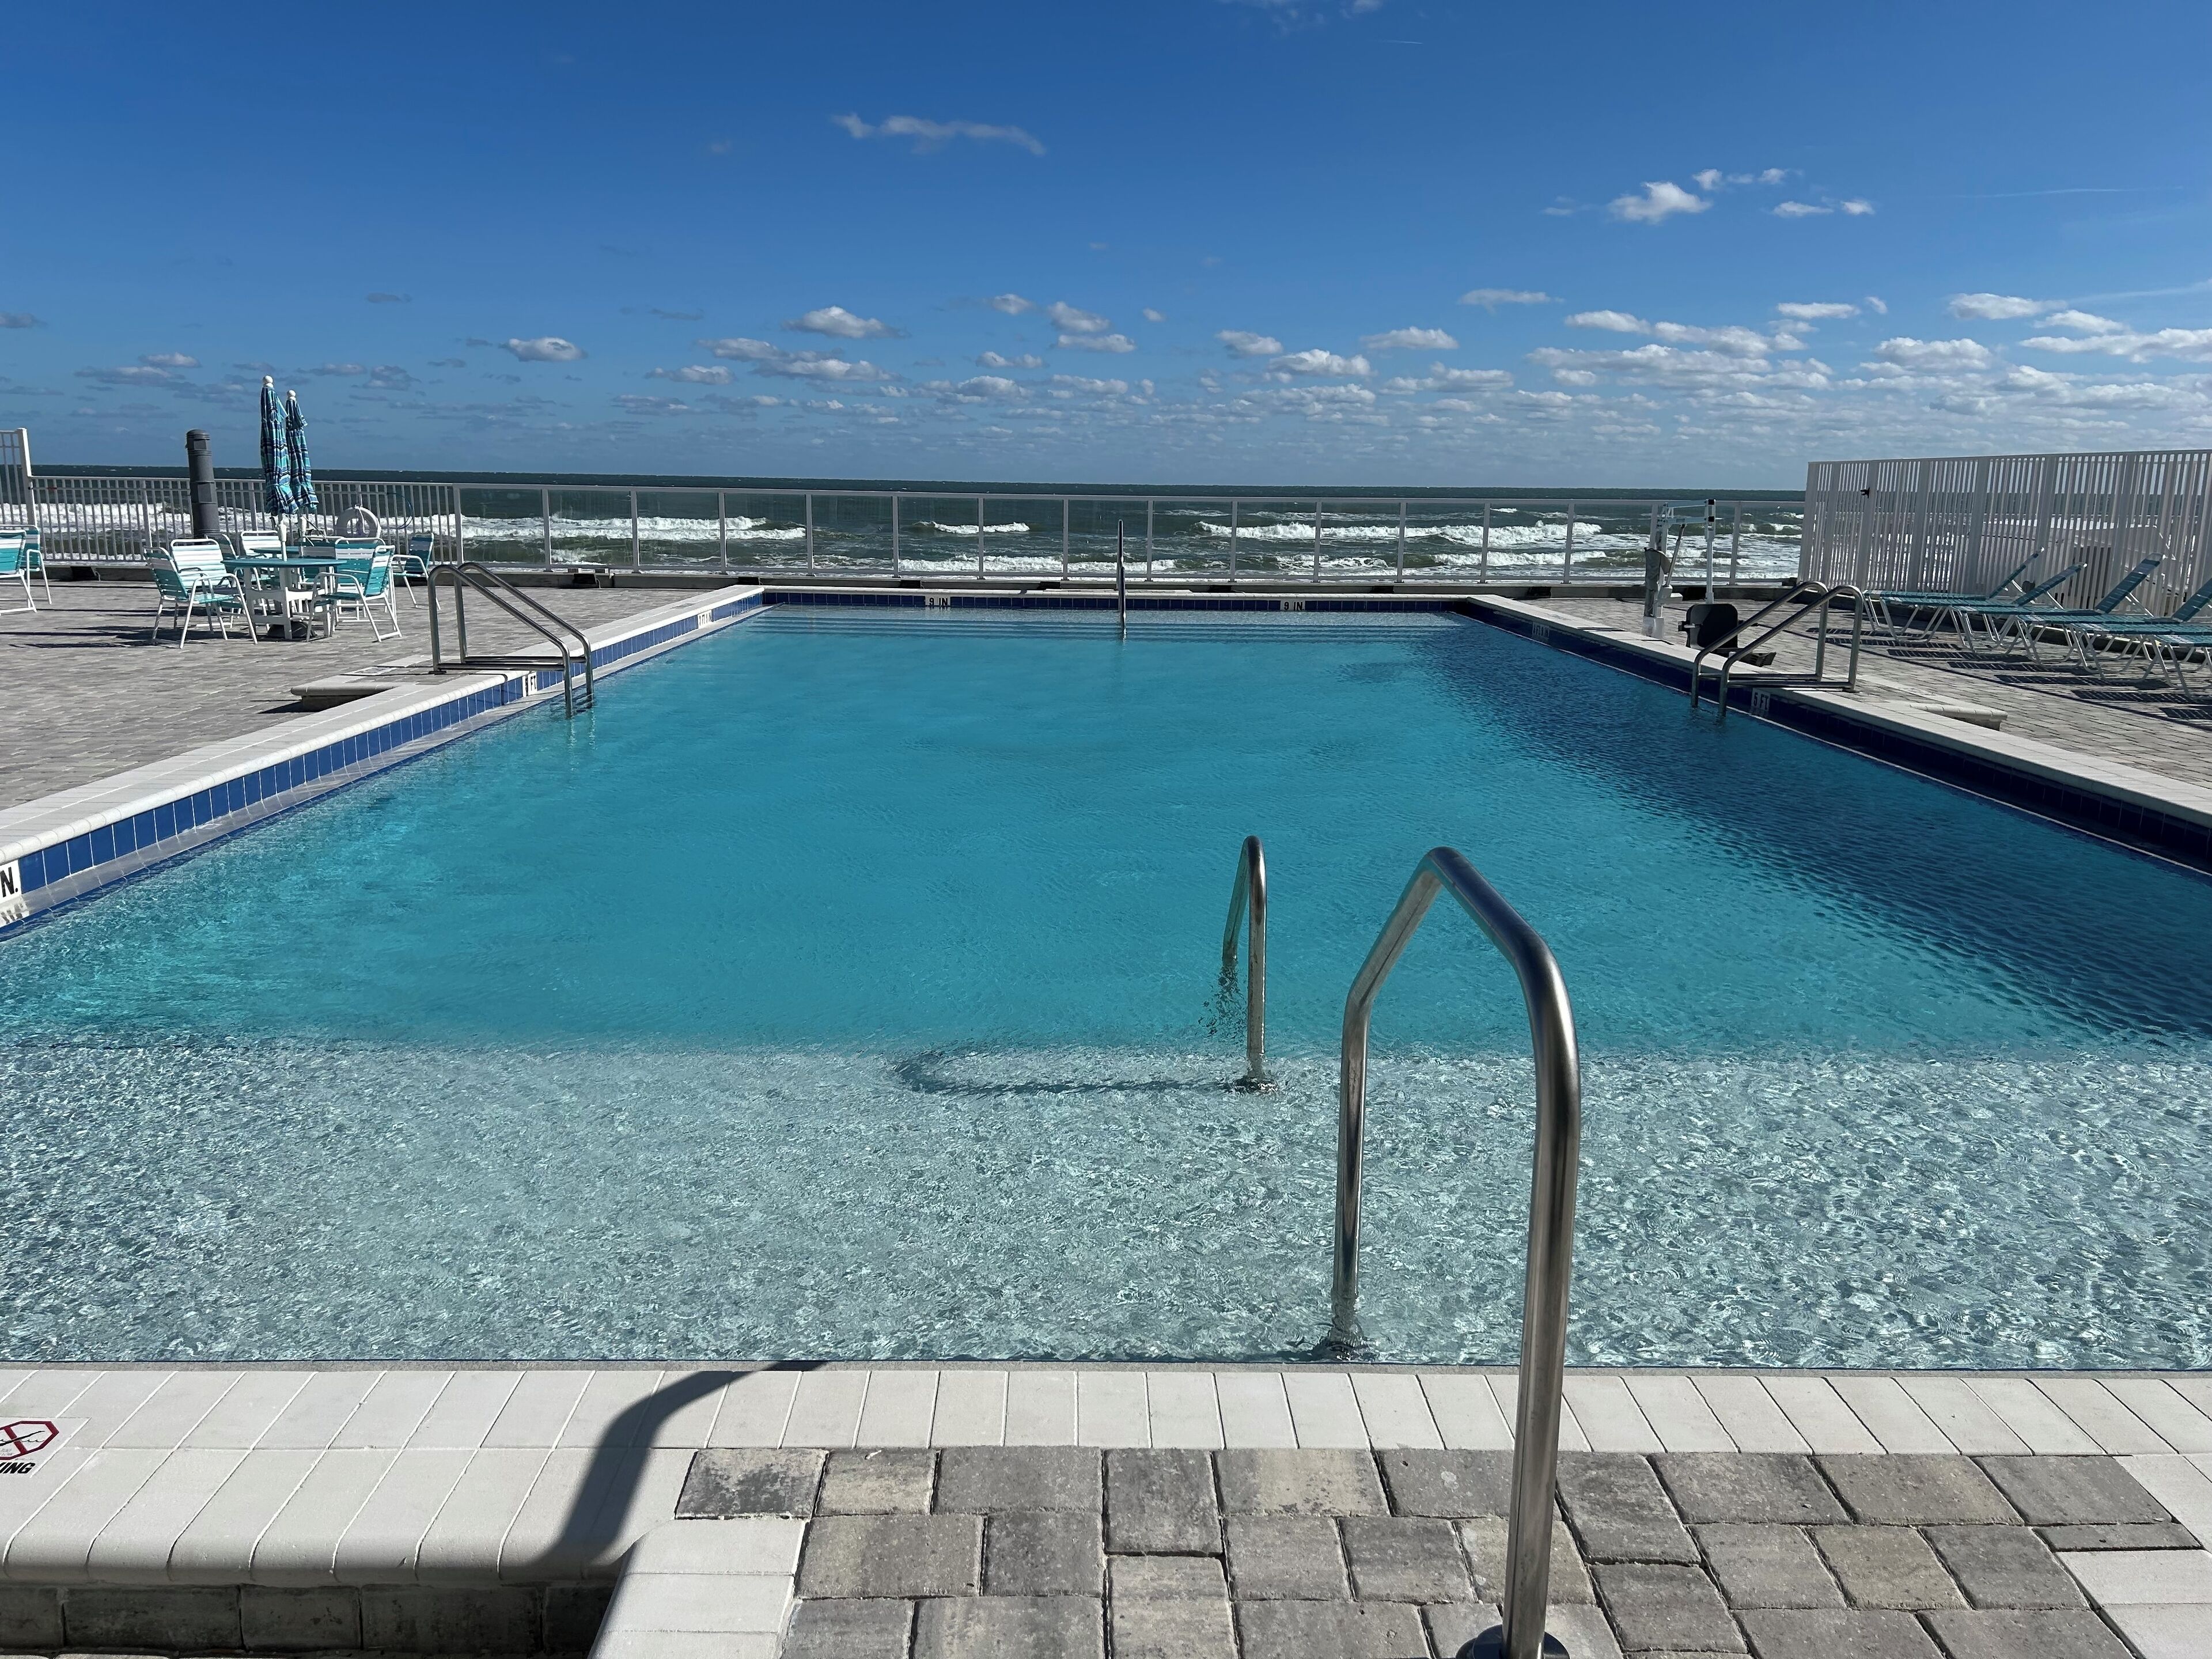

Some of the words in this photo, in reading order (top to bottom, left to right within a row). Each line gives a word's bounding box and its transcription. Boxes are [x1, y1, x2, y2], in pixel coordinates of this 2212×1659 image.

[1284, 601, 1289, 610] 9
[1753, 692, 1758, 706] 5
[1760, 694, 1769, 710] FT
